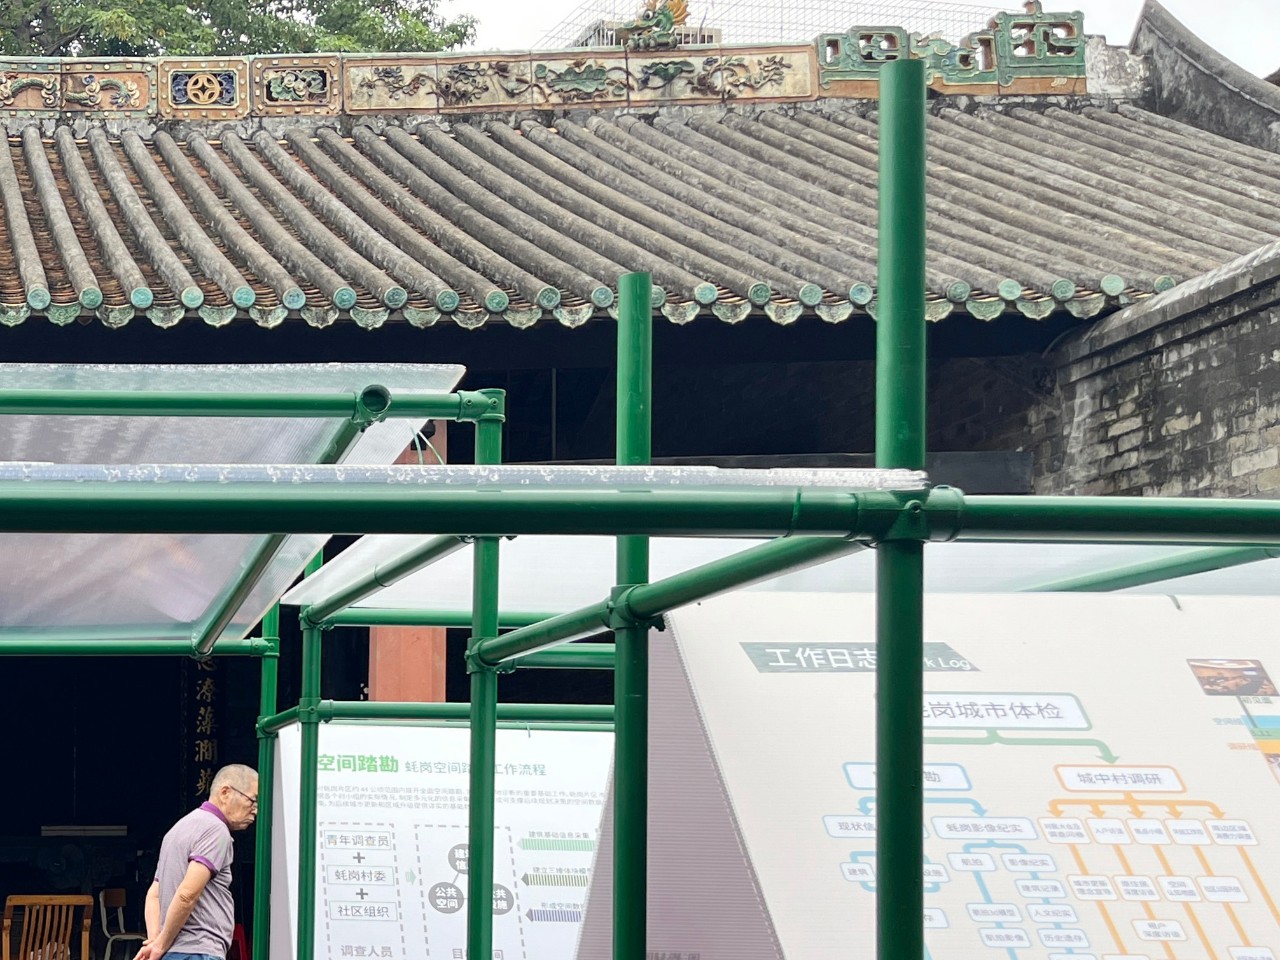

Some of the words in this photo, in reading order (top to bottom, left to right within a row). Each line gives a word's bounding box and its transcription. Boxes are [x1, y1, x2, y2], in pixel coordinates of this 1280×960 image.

[765, 647, 877, 668] 工作日志
[937, 656, 971, 671] Log
[318, 754, 399, 773] 空间踏勘
[1076, 773, 1163, 784] 城中村调研
[946, 823, 1024, 833] 蚝岗影像纪实
[326, 834, 390, 847] 青年调查员
[335, 869, 386, 882] 蚝岗村委
[435, 887, 458, 898] 公共
[436, 898, 458, 910] 空间
[338, 904, 390, 918] 社区组织
[341, 944, 393, 958] 调查人员
